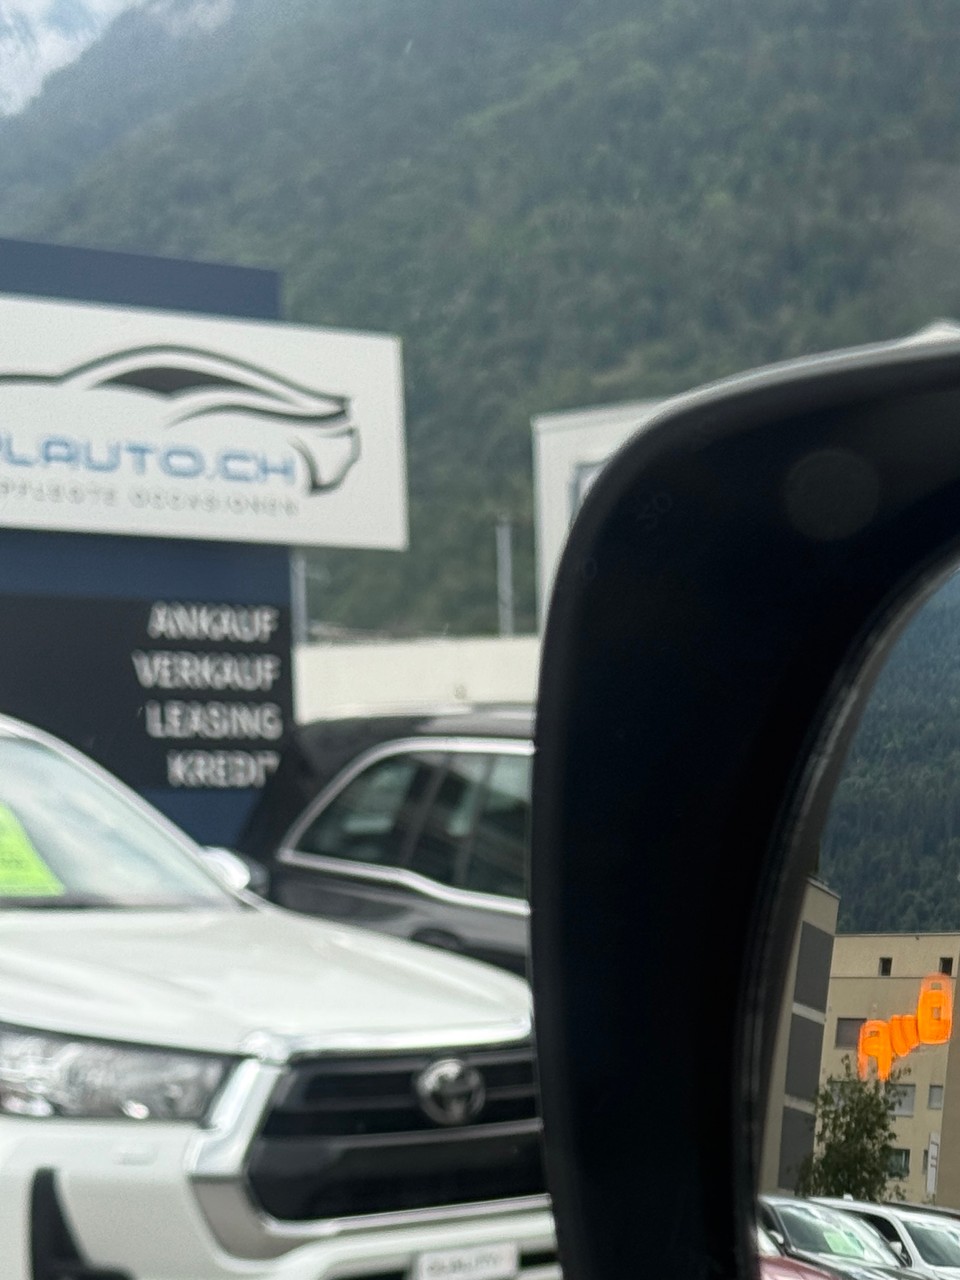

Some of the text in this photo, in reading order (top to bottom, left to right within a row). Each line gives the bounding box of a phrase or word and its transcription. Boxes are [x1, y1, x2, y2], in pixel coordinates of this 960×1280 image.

[0, 433, 297, 484] LAUTO.CH
[148, 601, 280, 642] ANKAUF
[132, 650, 281, 691] VERKAUF
[145, 701, 283, 740] LEASING
[167, 751, 280, 787] KREDIT
